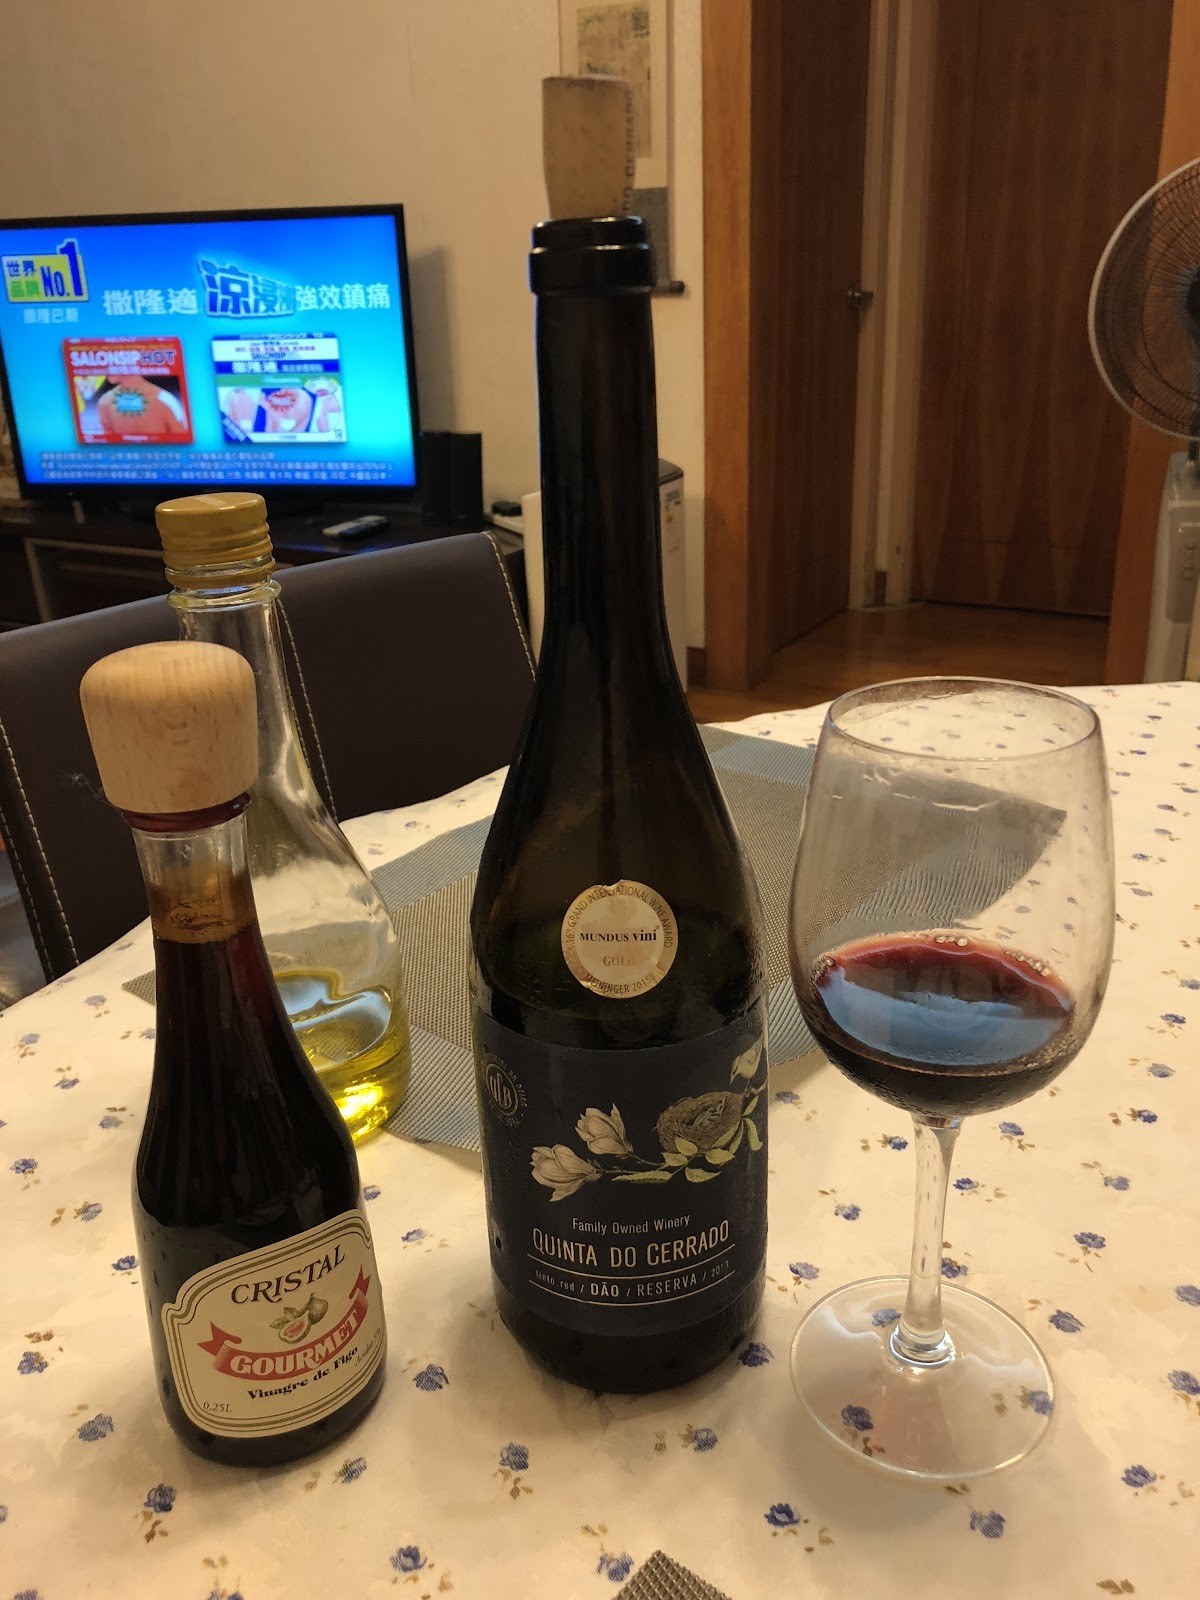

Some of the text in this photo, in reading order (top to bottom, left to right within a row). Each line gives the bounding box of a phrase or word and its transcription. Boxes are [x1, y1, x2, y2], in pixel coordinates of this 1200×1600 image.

[295, 282, 391, 311] 強效鎮痛
[580, 929, 657, 943] MUNDUS vini
[587, 885, 650, 905] INTERATIONAL
[649, 898, 667, 917] WINE
[661, 918, 674, 949] AWARD
[532, 1219, 729, 1268] QUINTA DO CERRADO
[572, 1214, 690, 1236] Family Owned Winery
[230, 1243, 346, 1304] CRISTAL
[590, 1281, 619, 1298] DÃO
[636, 1272, 697, 1297] RESERVA
[229, 1310, 360, 1376] GOURMET
[247, 1346, 358, 1400] Vinagre de Figo
[203, 1400, 232, 1413] 0.25L
